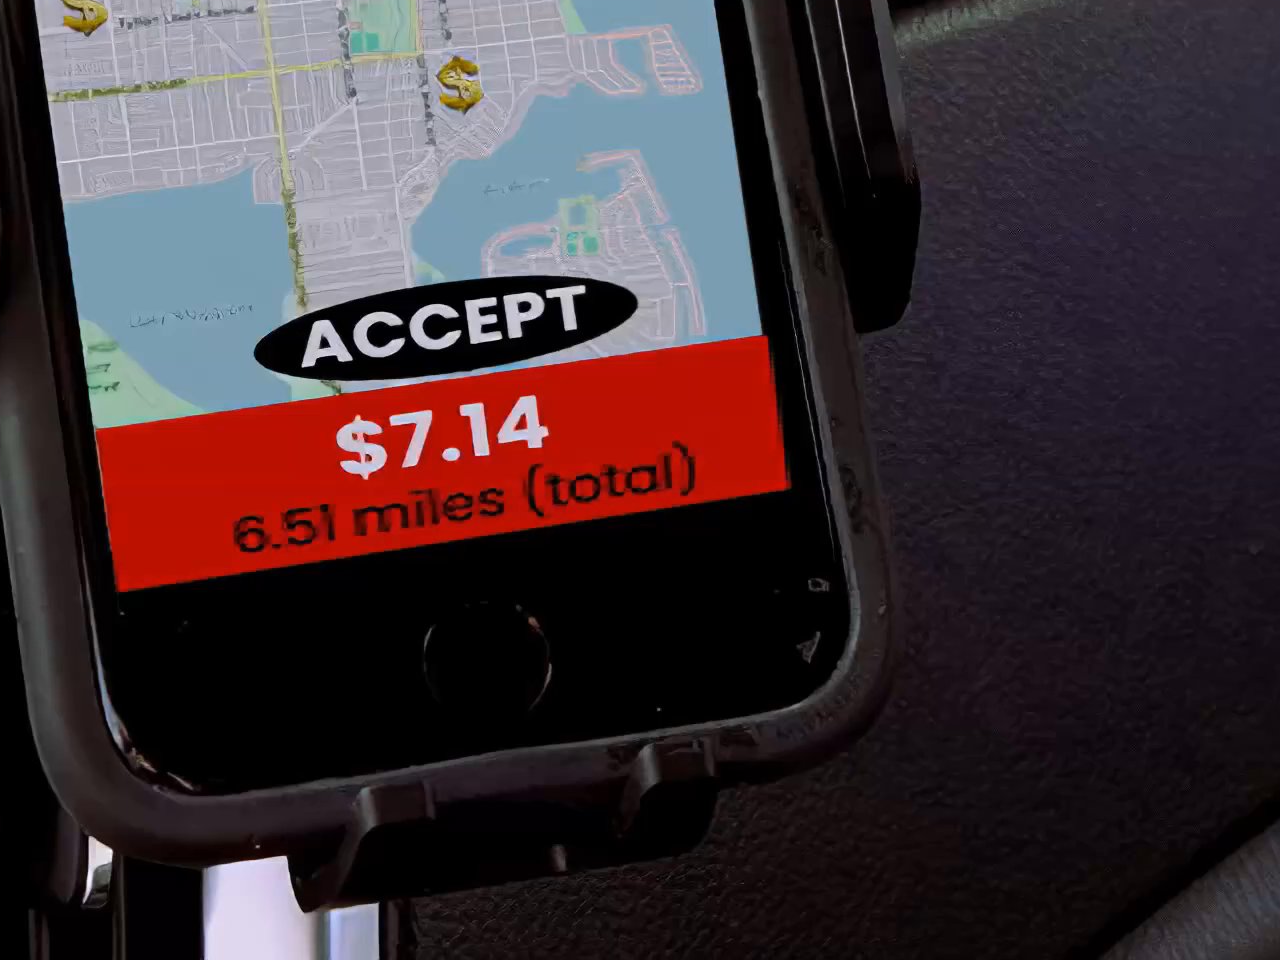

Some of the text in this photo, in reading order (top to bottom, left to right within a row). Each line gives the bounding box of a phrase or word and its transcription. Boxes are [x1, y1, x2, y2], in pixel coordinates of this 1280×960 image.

[300, 284, 587, 369] ACCEPT
[335, 394, 550, 481] $7.14
[232, 441, 698, 554] 6.51 miles (total)
